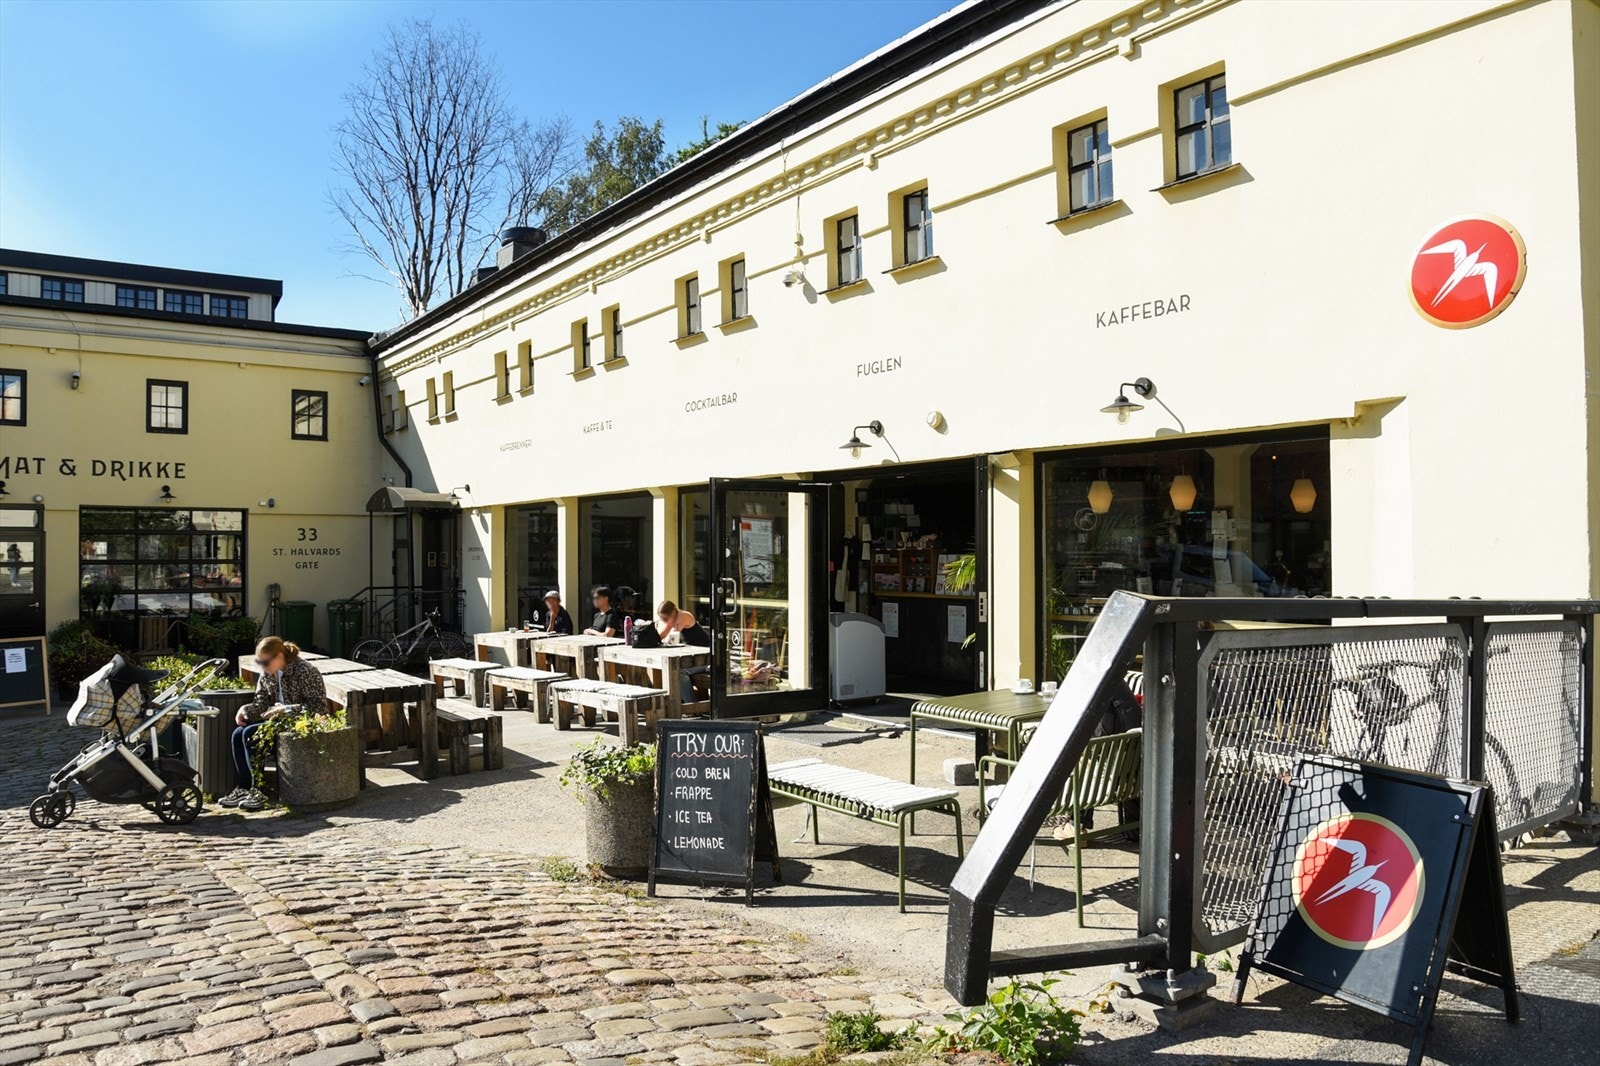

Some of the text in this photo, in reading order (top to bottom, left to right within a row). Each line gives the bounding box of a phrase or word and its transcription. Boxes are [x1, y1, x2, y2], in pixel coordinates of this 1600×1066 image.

[1096, 294, 1191, 328] KAFFEBAR
[857, 355, 902, 378] FUGLEN
[685, 392, 738, 413] COCKTAILBAR
[583, 422, 599, 433] KAFFE
[606, 419, 612, 430] TE
[59, 458, 77, 477] &
[91, 459, 187, 482] DRIKKE
[297, 528, 318, 541] 33
[272, 548, 341, 556] ST. HALVARDS
[295, 561, 320, 569] GATE
[670, 732, 707, 753] TRY
[675, 766, 731, 780] COLD BREW
[675, 786, 713, 800] FRAPPE
[675, 810, 713, 824] ICE TEA
[674, 836, 725, 850] LEMONADE
